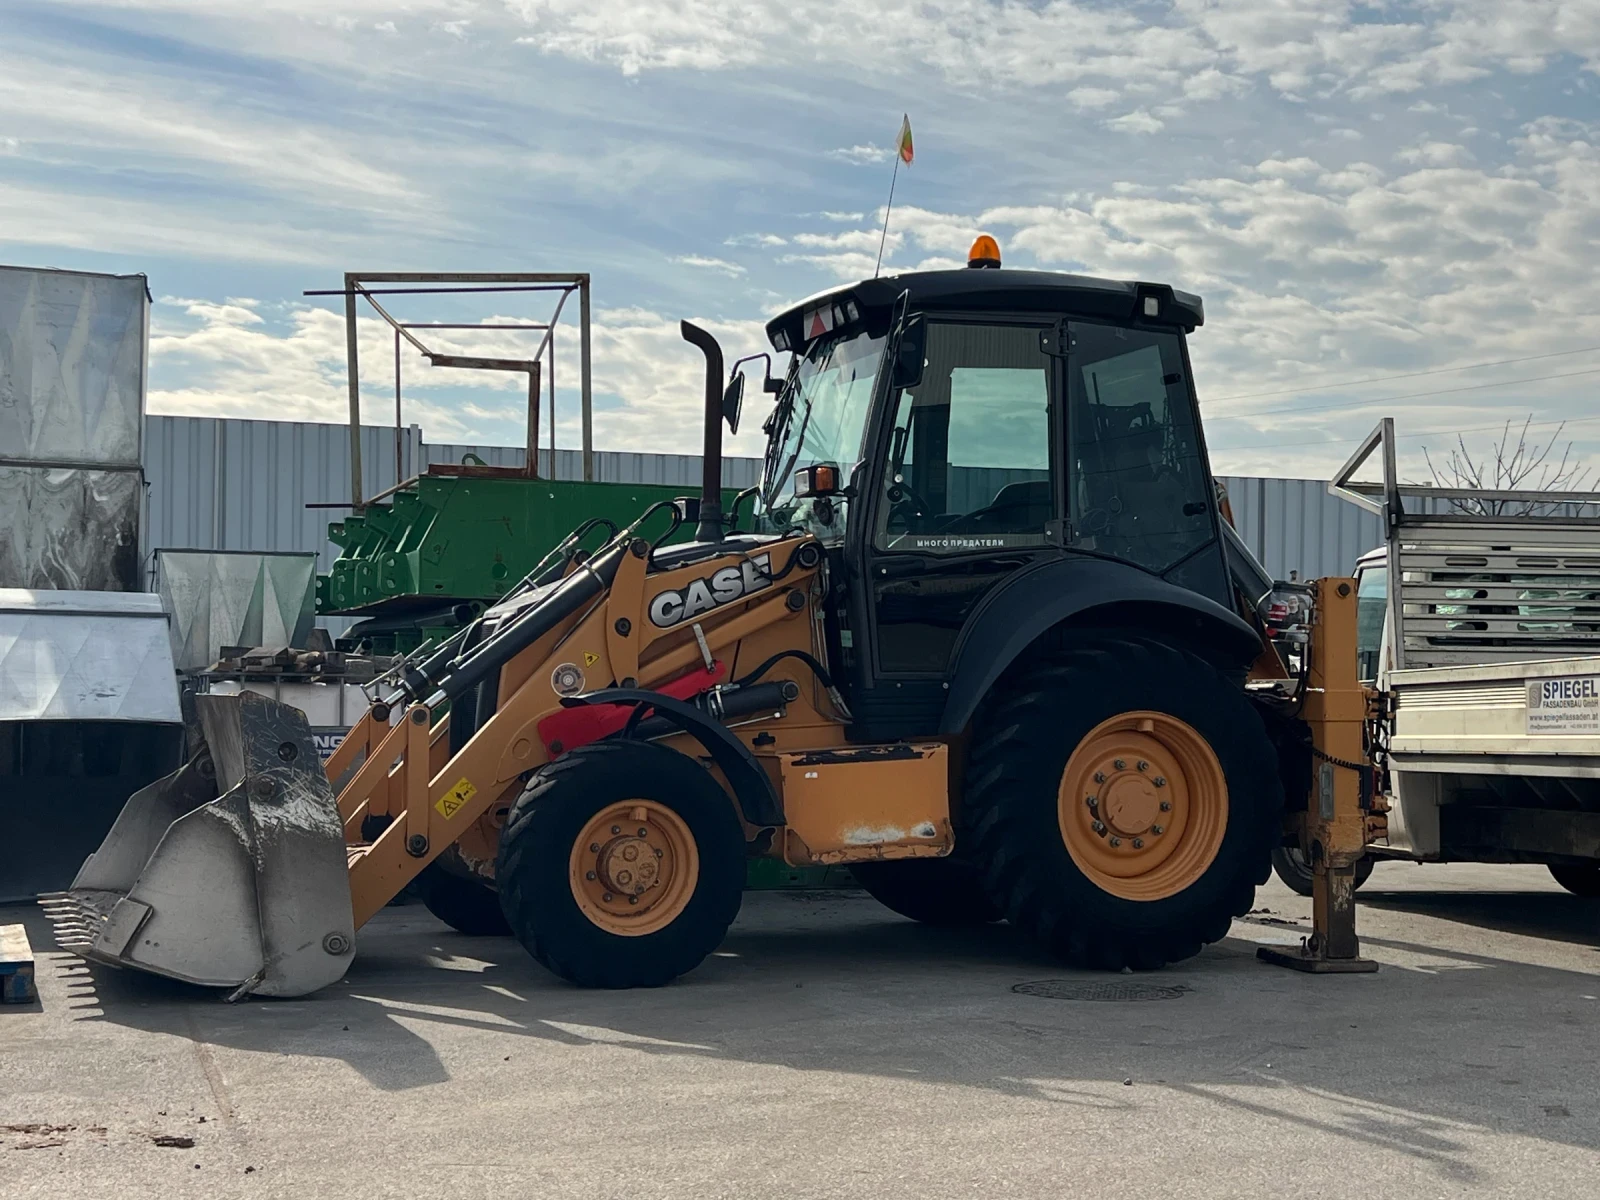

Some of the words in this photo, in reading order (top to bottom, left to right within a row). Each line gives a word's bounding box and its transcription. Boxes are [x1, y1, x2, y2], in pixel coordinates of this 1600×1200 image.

[917, 539, 949, 547] МНОГО
[950, 539, 1004, 547] ПРЕДАТЕЛИ
[649, 552, 773, 628] CASE
[1543, 680, 1599, 699] SPIEGEL
[1542, 699, 1582, 708] FASSADENBAU
[1529, 713, 1599, 722] www.spiegelfassaden.at
